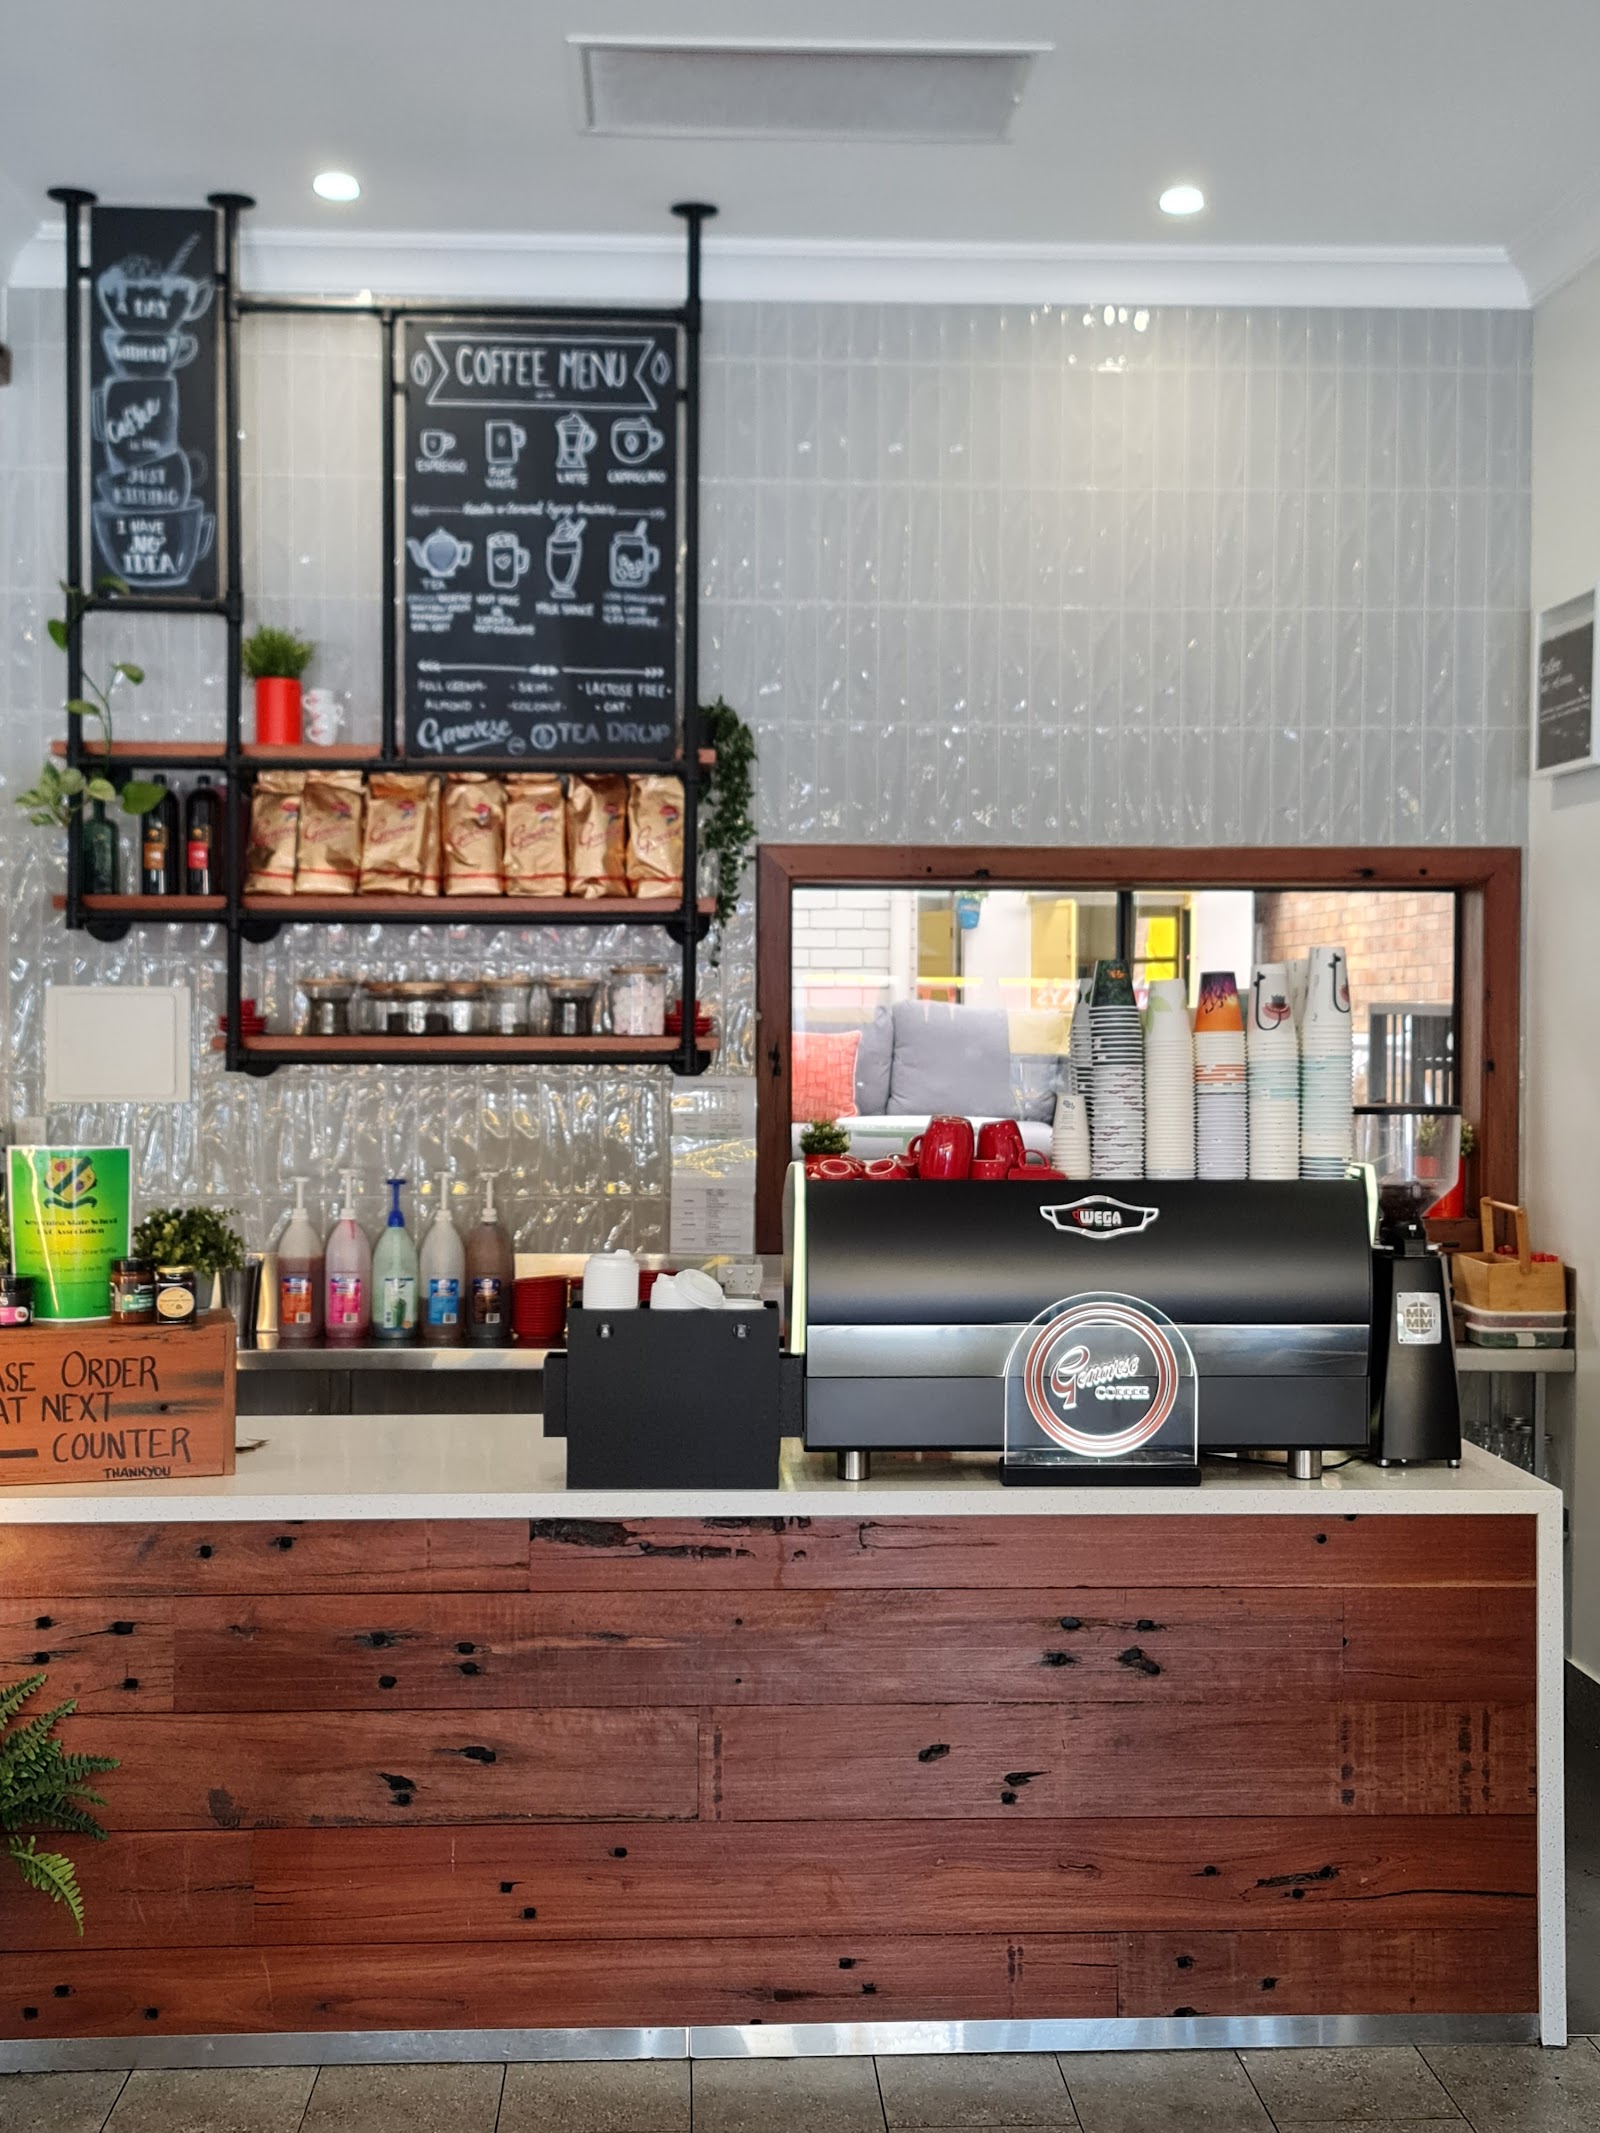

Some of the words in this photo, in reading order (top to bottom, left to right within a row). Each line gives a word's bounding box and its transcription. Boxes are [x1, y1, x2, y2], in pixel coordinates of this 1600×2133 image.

[134, 298, 168, 319] DAY
[456, 345, 550, 387] COFFEE
[558, 351, 627, 389] MENU
[415, 458, 467, 472] ESPRESSO
[128, 468, 166, 484] JUST
[556, 472, 589, 485] LATTE
[115, 489, 178, 506] KIDDING
[117, 519, 126, 534] I
[130, 519, 164, 534] HAVE
[129, 535, 166, 553] NO
[422, 578, 447, 590] TEA
[418, 680, 444, 692] FULL
[446, 681, 482, 692] CREAM
[518, 682, 547, 693] SKIM
[585, 681, 633, 697] LACTOSE
[638, 683, 666, 699] FREE
[425, 699, 472, 712] ALMOND
[557, 722, 600, 743] TEA
[606, 722, 671, 743] DROP
[91, 1217, 118, 1226] School
[1080, 1210, 1122, 1226] WEGA
[61, 1350, 159, 1392] ORDER
[1095, 1385, 1150, 1401] COFFEE
[42, 1391, 114, 1423] NEXT
[53, 1427, 191, 1463] COUNTER
